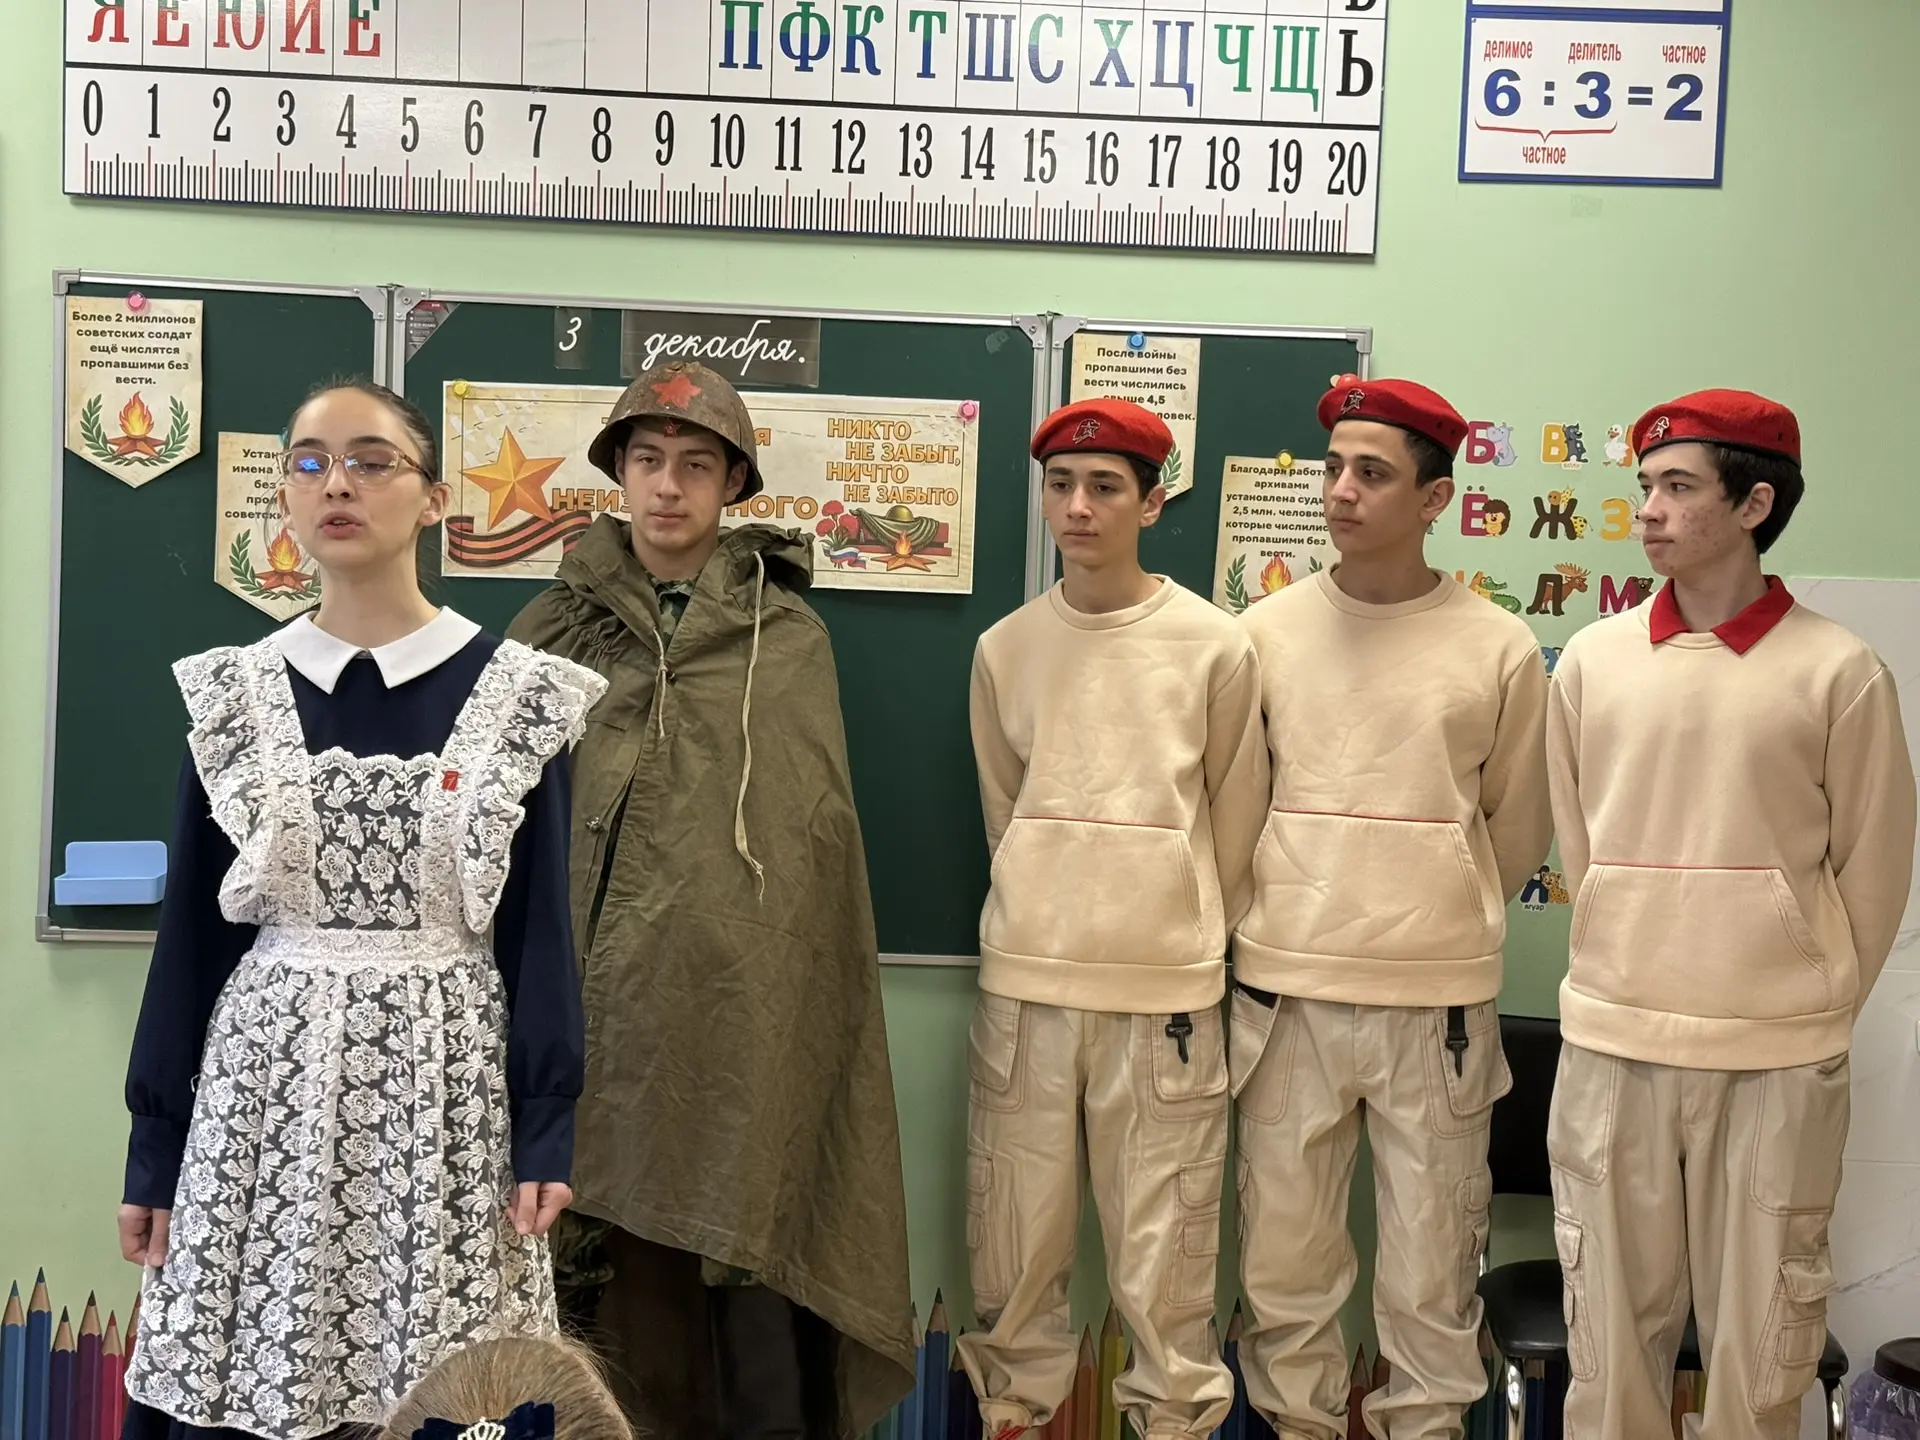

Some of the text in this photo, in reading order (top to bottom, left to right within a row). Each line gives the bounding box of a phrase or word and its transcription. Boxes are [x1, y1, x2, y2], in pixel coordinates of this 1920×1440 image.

[87, 0, 129, 43] Я
[213, 0, 265, 50] Ю
[280, 0, 325, 54] И
[343, 0, 381, 57] Е
[719, 1, 764, 70] П
[779, 1, 830, 72] Ф
[841, 5, 885, 76] К
[909, 10, 946, 78] Т
[963, 13, 1016, 82] Ш
[1028, 14, 1063, 84] С
[1090, 18, 1135, 87] Х
[1150, 20, 1194, 107] Ц
[1214, 24, 1254, 92] Ч
[1270, 25, 1320, 112] Щ
[1336, 29, 1374, 97] Ь
[1483, 40, 1706, 64] делимое делитель частное
[1484, 68, 1521, 117] 6
[1573, 71, 1612, 119] 3
[1663, 73, 1704, 121] 2
[83, 80, 1367, 196] 0 1 2 3 4 5 6 7 8 9 10 11 12 13 14 15 16 17 18 19 20
[1522, 146, 1566, 165] частное
[72, 312, 196, 324] Более 2 миллионов
[76, 329, 192, 341] советских солдат
[90, 343, 180, 354] ещё числятся
[558, 317, 805, 376] 3 декабря.
[1097, 347, 1176, 360] После войны
[80, 360, 189, 371] пропавшими без
[1085, 363, 1187, 375] пропавшими без
[115, 376, 157, 385] вести.
[1084, 379, 1187, 390] вести числились
[1146, 394, 1166, 406] 4,5
[827, 418, 912, 441] НИКТО
[1465, 420, 1569, 465] Б В
[845, 442, 961, 466] НЕ ЗАБЫТ,
[232, 465, 273, 474] имена
[825, 461, 910, 484] НИЧТО
[1230, 464, 1287, 477] Благодаря
[254, 480, 277, 489] без
[1254, 481, 1309, 490] архивами
[843, 484, 959, 506] НЕ ЗАБЫТО
[1226, 493, 1296, 503] установлена
[1233, 506, 1249, 516] 2,5
[1251, 509, 1276, 517] млн.
[1461, 485, 1632, 541] Ё Ж З
[1225, 521, 1272, 531] которые
[1232, 535, 1327, 546] пропавшими без
[1260, 550, 1296, 559] вести.
[1526, 573, 1565, 617] Л
[1598, 575, 1639, 614] М
